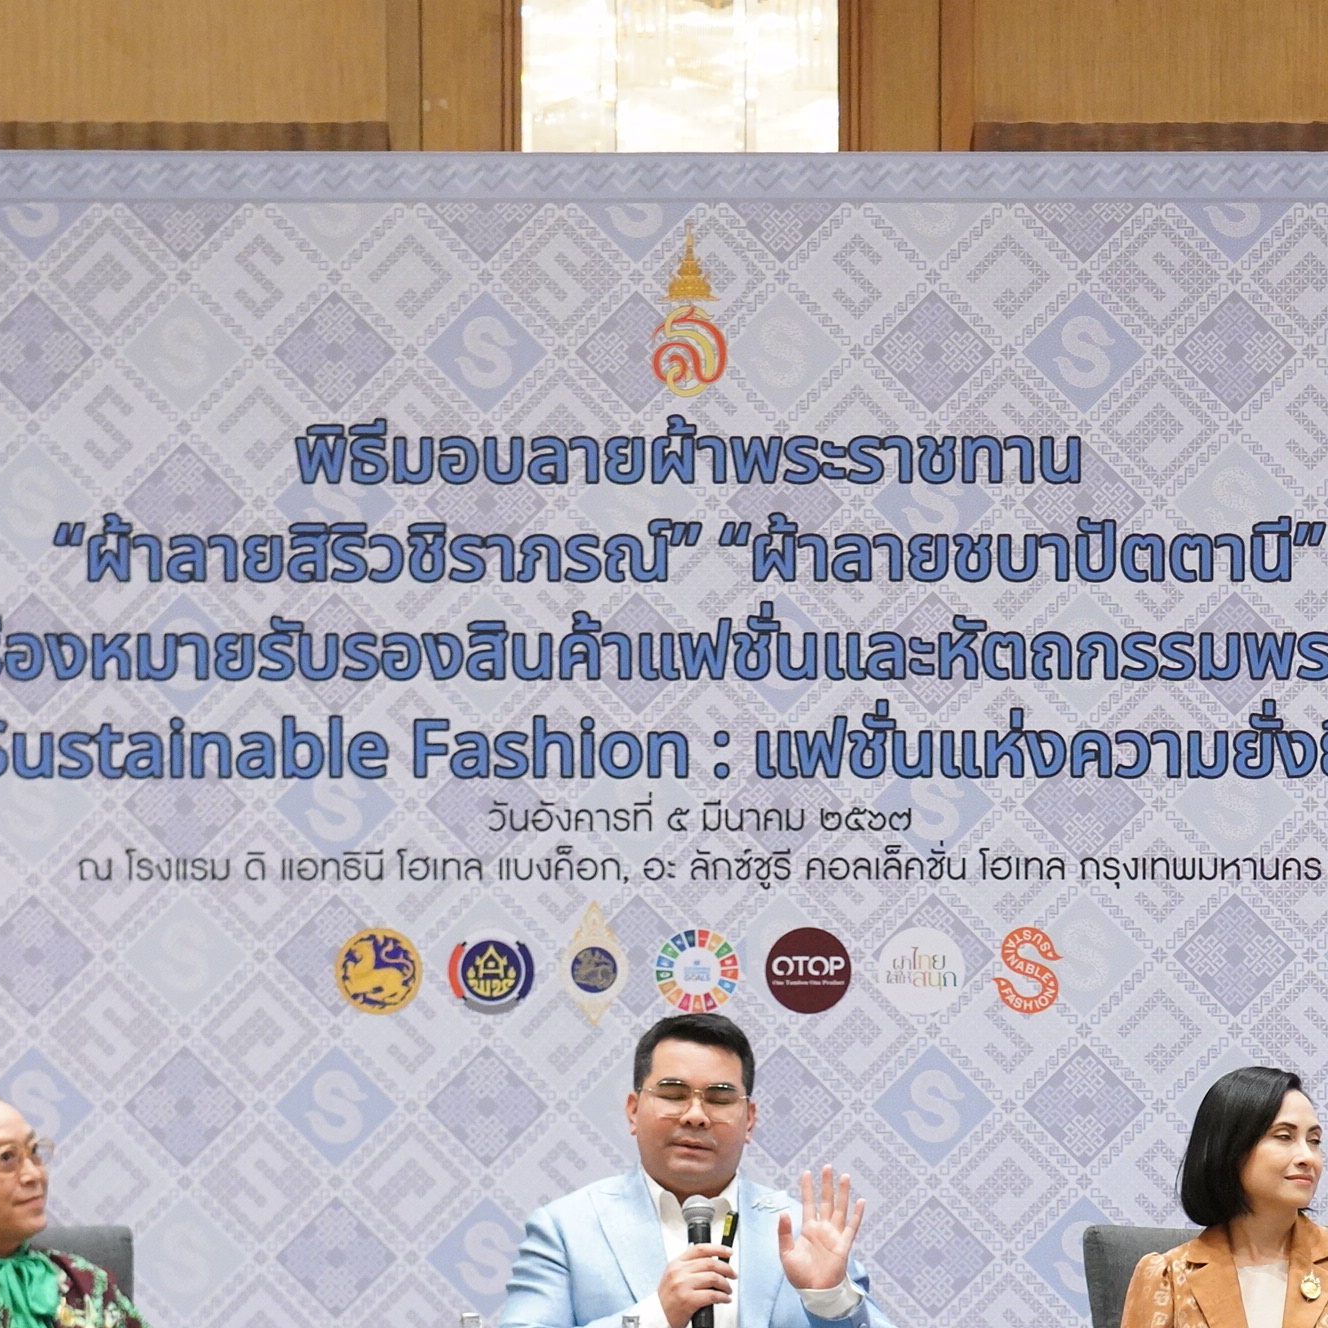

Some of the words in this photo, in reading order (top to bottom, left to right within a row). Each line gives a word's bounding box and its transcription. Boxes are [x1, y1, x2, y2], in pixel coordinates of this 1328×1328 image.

[294, 414, 1082, 486] พิธีมอบลายผ้าพระราชทาน
[413, 714, 690, 780] Fashion
[488, 791, 652, 832] วันอังคารที่
[667, 807, 690, 832] ๕
[702, 799, 805, 832] มีนาคม
[820, 806, 912, 832] ๒๕๖๗
[78, 858, 112, 881] ณ
[125, 848, 230, 881] โรงแรม
[245, 852, 266, 881] ดิ
[282, 849, 384, 881] แอทธินี
[396, 848, 483, 881] โฮเทล
[499, 845, 629, 884] แบงค็อก,
[643, 857, 676, 881] อะ
[690, 848, 791, 890] ลักซ์ชูรี
[806, 840, 966, 881] คอลเล็คชั่น
[978, 847, 1065, 881] โฮเทล
[1079, 856, 1322, 890] กรุงเทพมหานคร
[772, 955, 846, 976] OTOP
[1004, 929, 1053, 984] SUSTAINABLE
[1001, 985, 1057, 1011] FASHION
